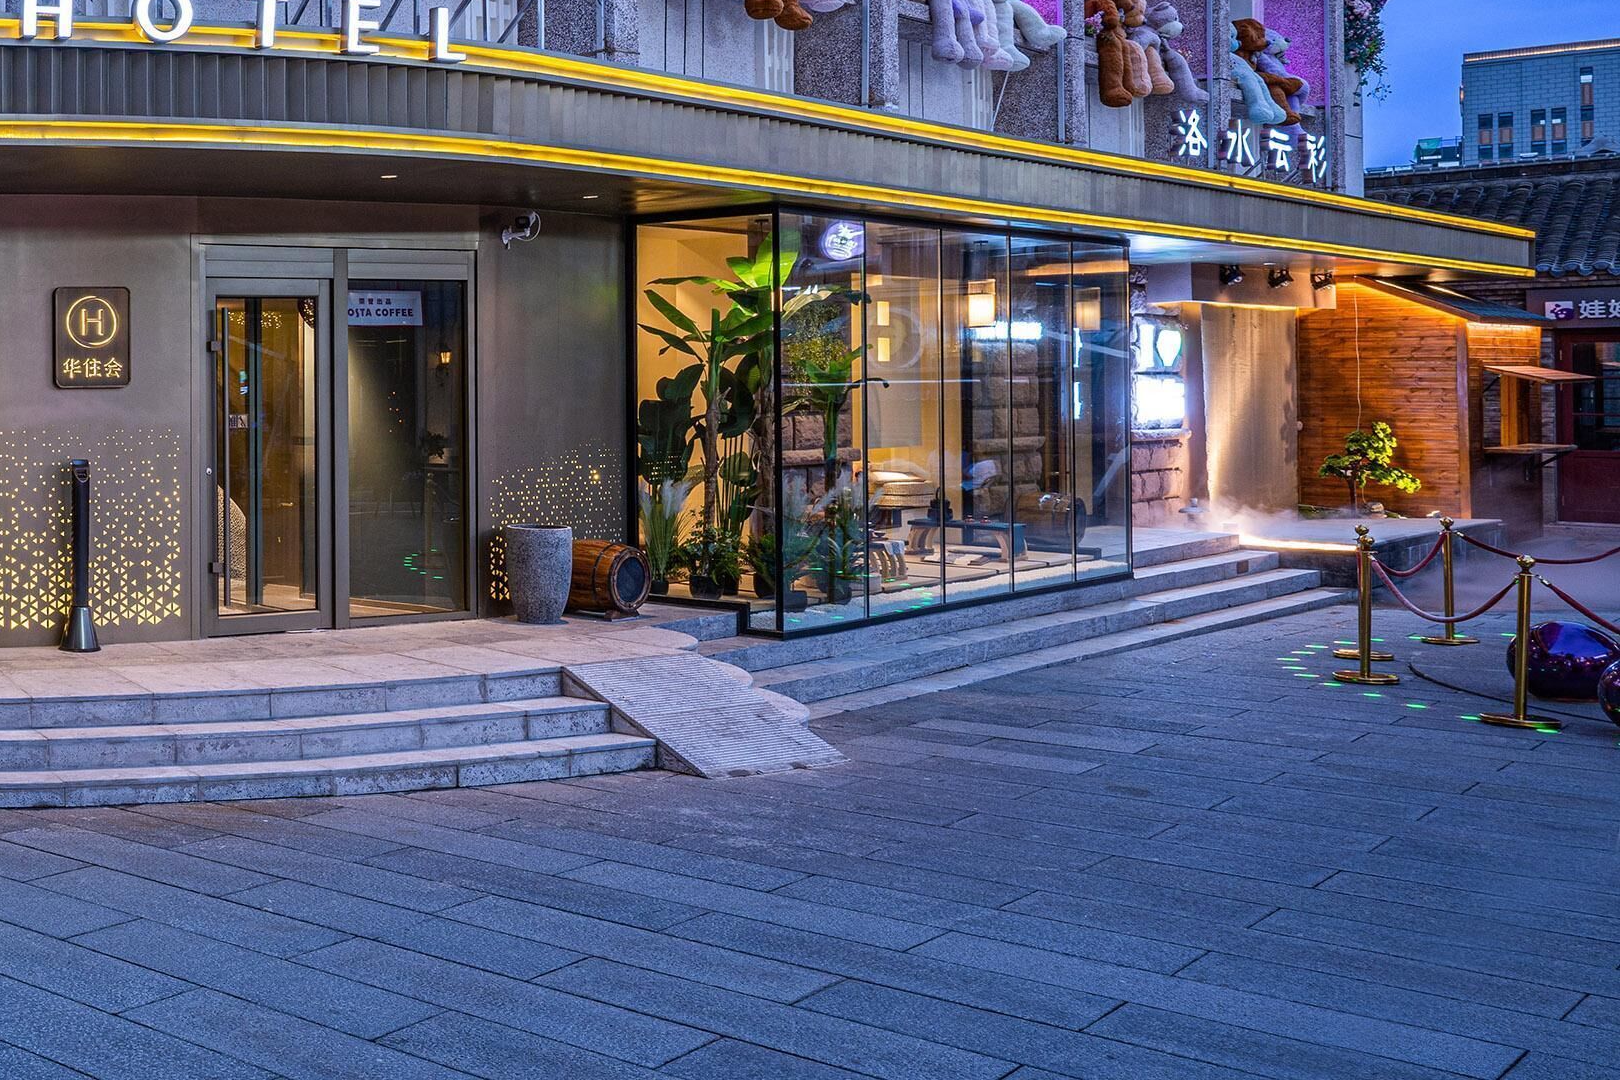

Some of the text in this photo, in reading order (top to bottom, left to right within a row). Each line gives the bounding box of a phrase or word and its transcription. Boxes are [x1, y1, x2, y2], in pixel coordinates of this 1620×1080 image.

[1178, 109, 1327, 183] 洛水云彩
[348, 308, 414, 318] OSTA COFFEE
[63, 357, 123, 379] 华住会
